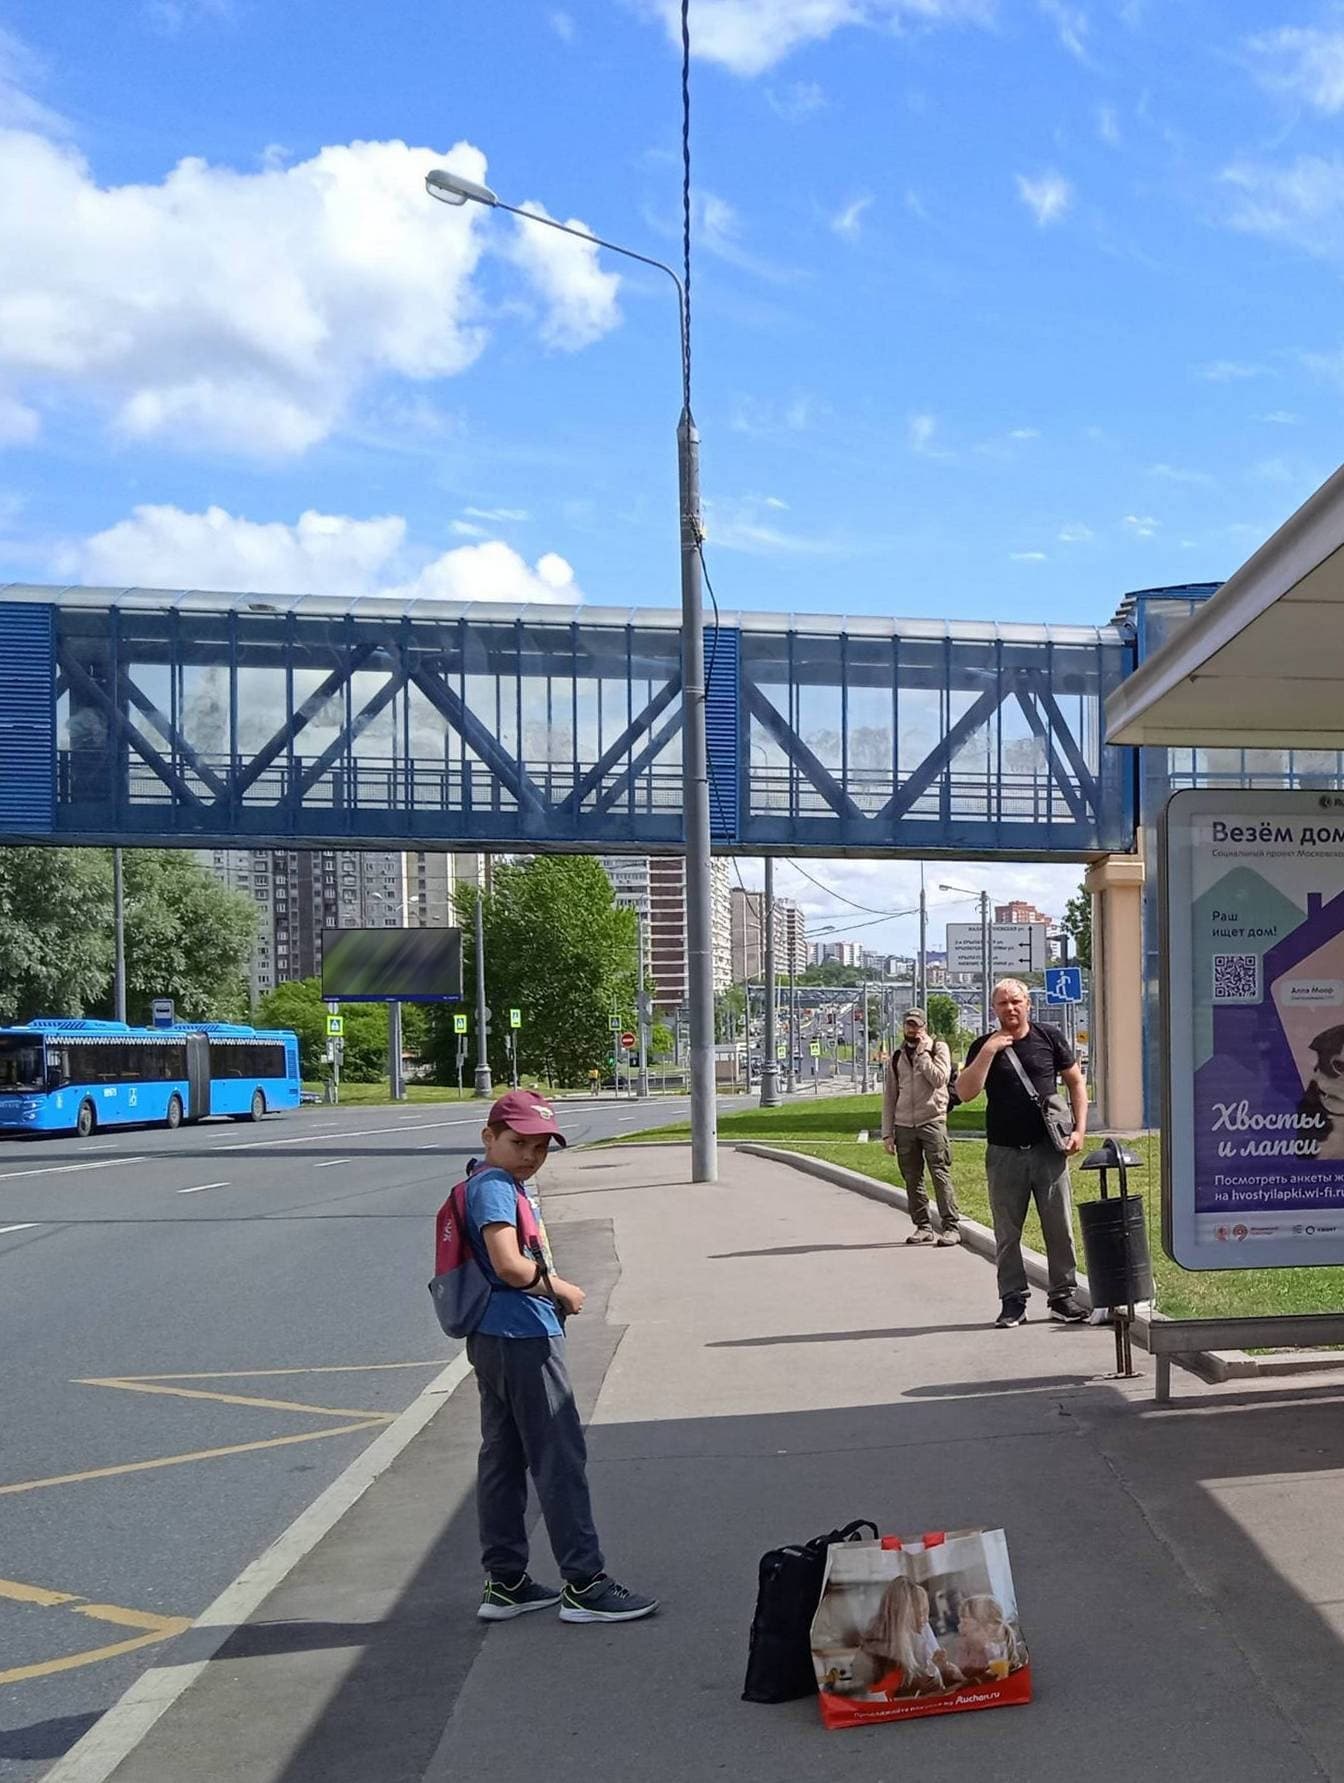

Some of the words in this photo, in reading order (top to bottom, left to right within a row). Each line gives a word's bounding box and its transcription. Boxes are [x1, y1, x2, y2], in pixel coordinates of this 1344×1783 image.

[1212, 821, 1293, 842] Везём
[1212, 849, 1264, 859] Социальный
[1265, 850, 1295, 858] проект
[1212, 911, 1238, 921] Раш
[1212, 927, 1245, 938] ищет
[1247, 926, 1277, 938] дом!
[1212, 1100, 1325, 1132] Хвосты
[1218, 1140, 1237, 1158] и
[1240, 1138, 1322, 1157] лапки
[1215, 1174, 1288, 1186] Посмотреть
[1290, 1173, 1332, 1183] анкеты
[1215, 1191, 1229, 1201] на
[956, 1692, 1000, 1705] Auchan.ru
